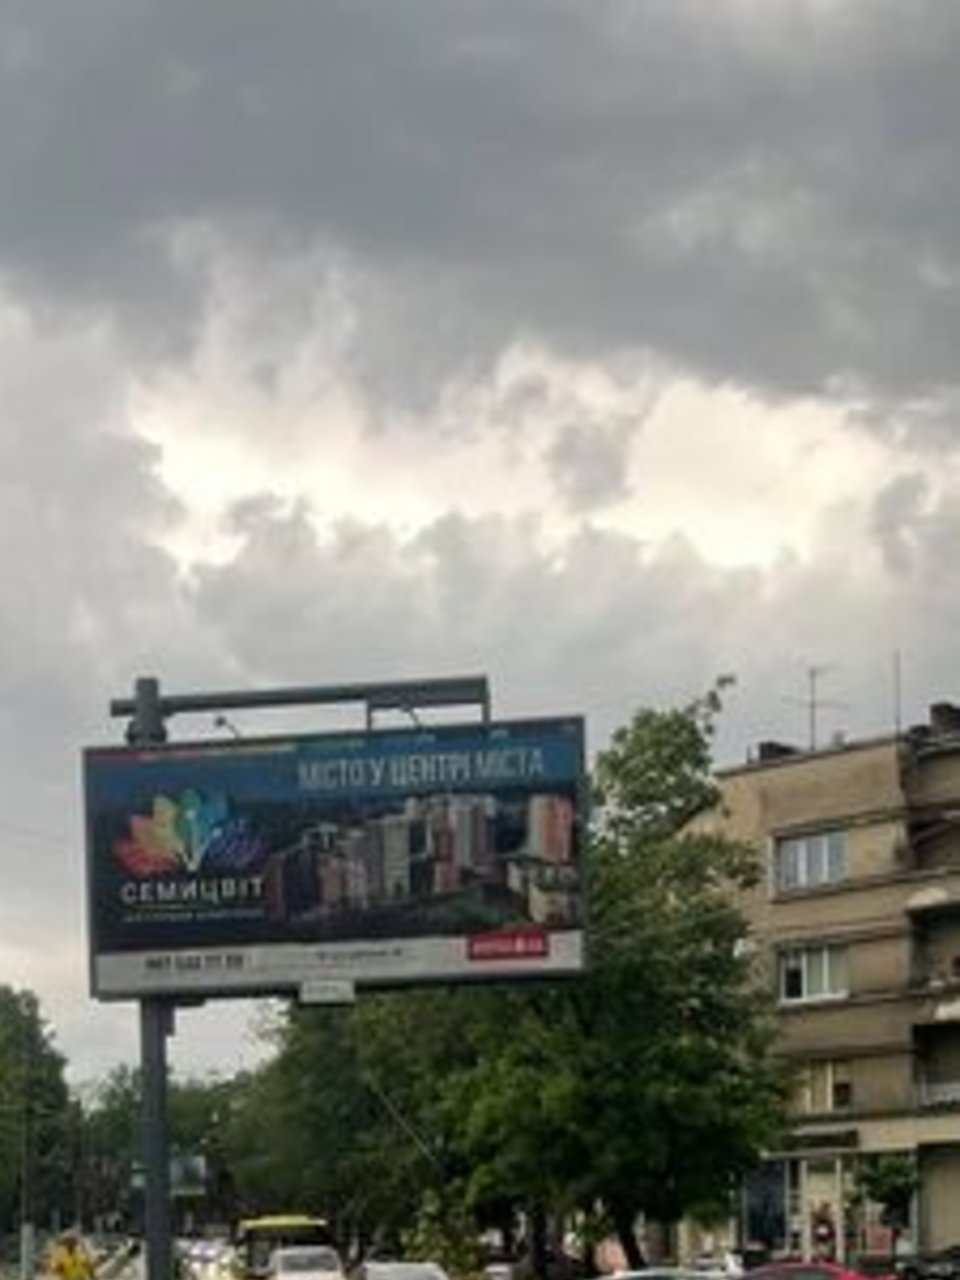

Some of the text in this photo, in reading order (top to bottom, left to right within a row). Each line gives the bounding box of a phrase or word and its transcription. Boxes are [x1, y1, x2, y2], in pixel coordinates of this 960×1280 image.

[298, 747, 543, 790] МІСТО У ЦЕНТРІ МІСТА
[120, 876, 264, 905] СЕМИЦВІТ
